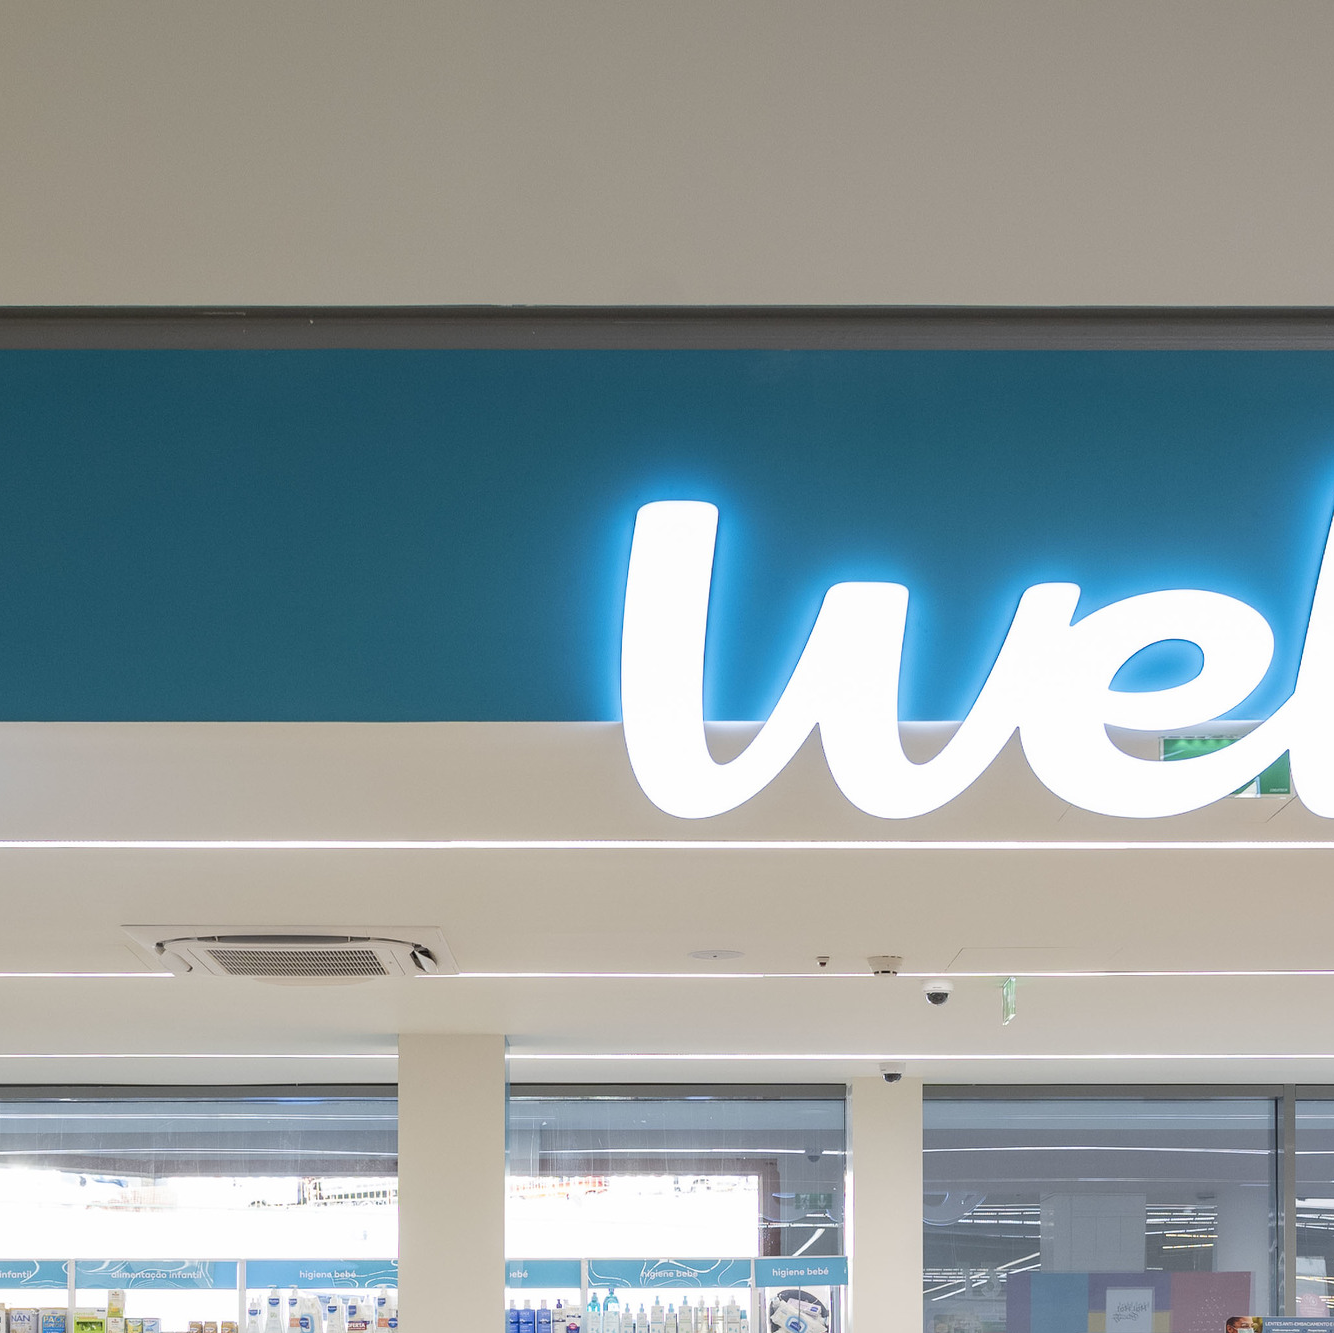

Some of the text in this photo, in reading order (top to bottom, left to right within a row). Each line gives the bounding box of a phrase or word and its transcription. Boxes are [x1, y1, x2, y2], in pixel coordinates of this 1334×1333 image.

[111, 1270, 202, 1280] alimentação infantil
[299, 1270, 356, 1280] higiene bebé
[640, 1269, 698, 1279] higiene bebé
[771, 1267, 829, 1277] higiene bebé
[11, 1314, 31, 1322] NAN
